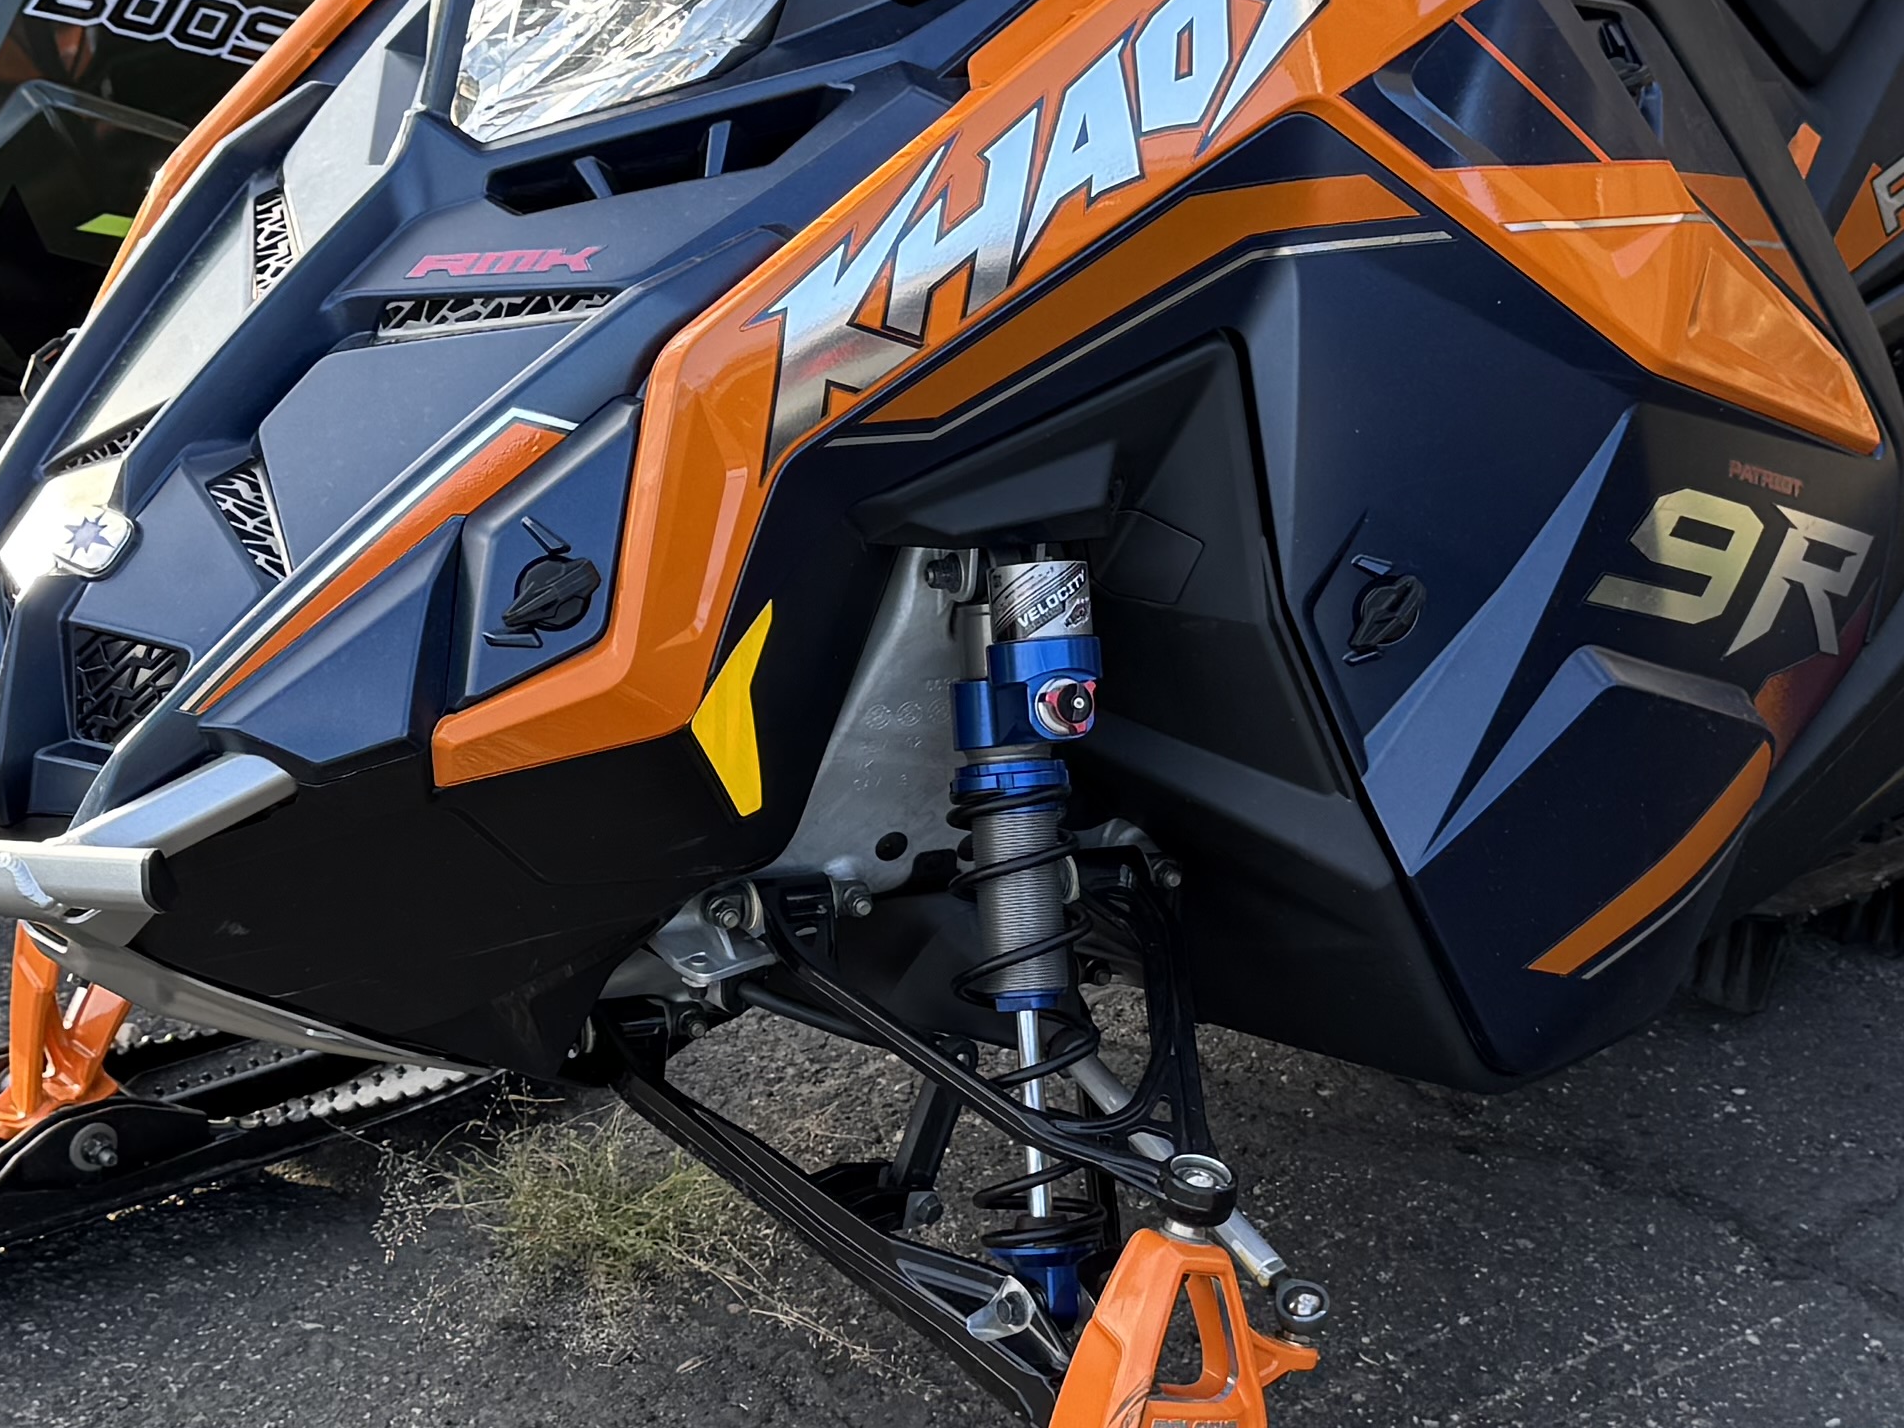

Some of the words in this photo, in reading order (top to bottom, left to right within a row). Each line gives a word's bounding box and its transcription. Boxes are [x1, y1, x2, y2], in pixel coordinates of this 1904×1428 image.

[403, 244, 609, 279] RMK
[1728, 460, 1805, 498] PATRIOT
[1016, 568, 1086, 628] VELOCITY
[1583, 487, 1876, 660] 9R
